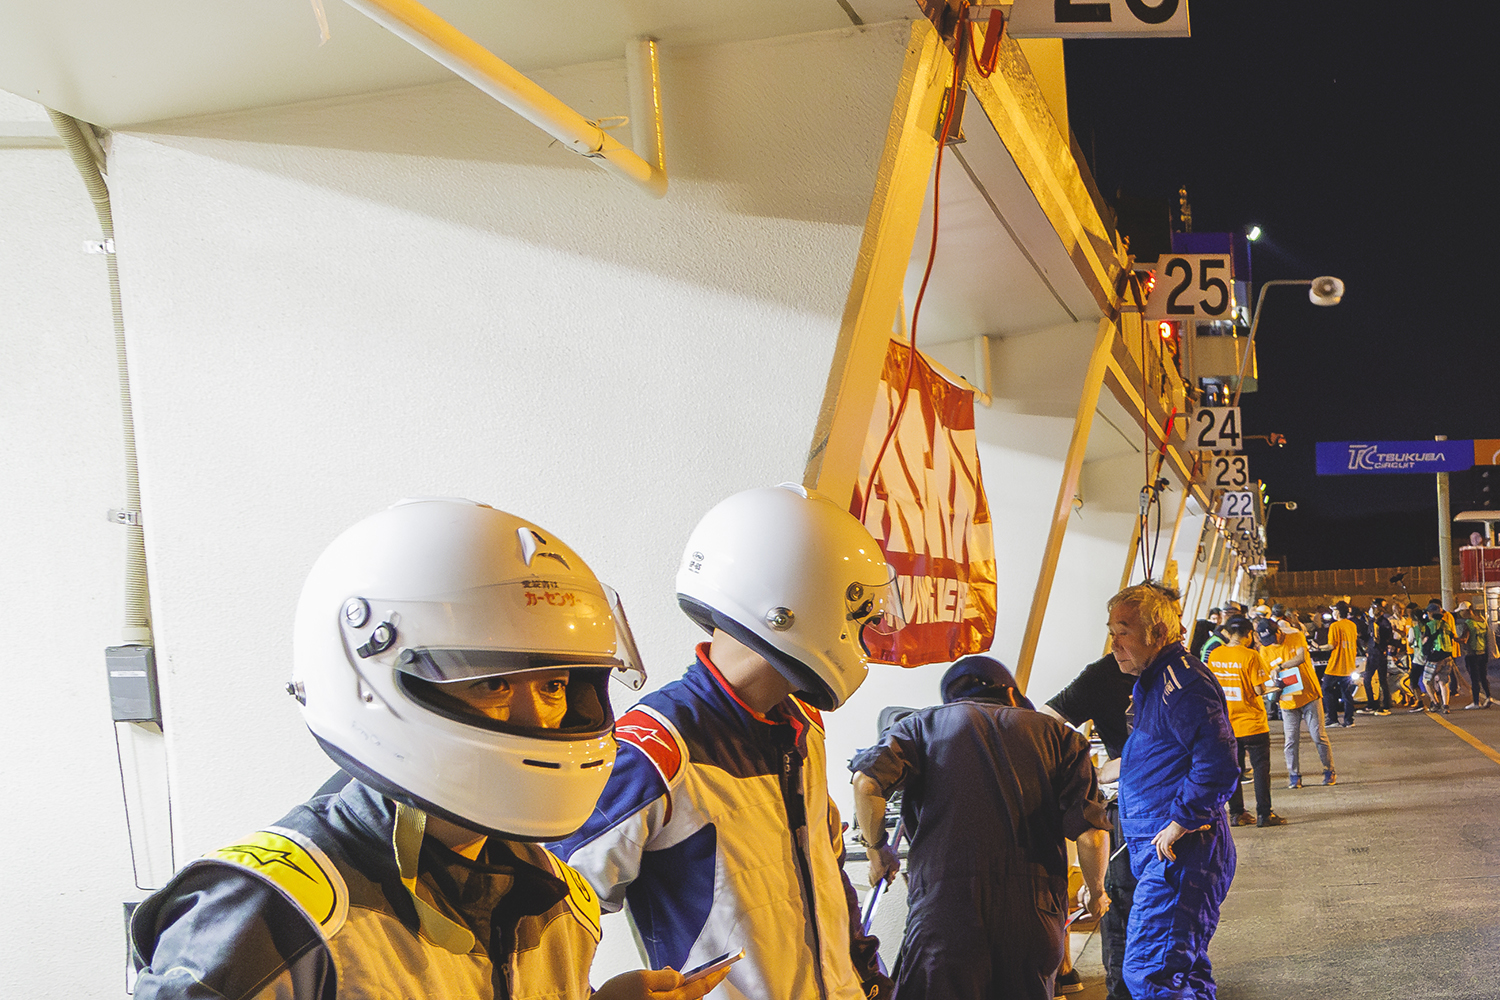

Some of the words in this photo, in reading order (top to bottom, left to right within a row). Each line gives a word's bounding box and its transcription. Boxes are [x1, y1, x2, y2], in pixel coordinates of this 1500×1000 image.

[1164, 257, 1229, 316] 25
[1196, 409, 1240, 447] 24
[1215, 457, 1247, 487] 23
[1376, 452, 1446, 462] TSUKUBA
[1227, 493, 1252, 516] 22
